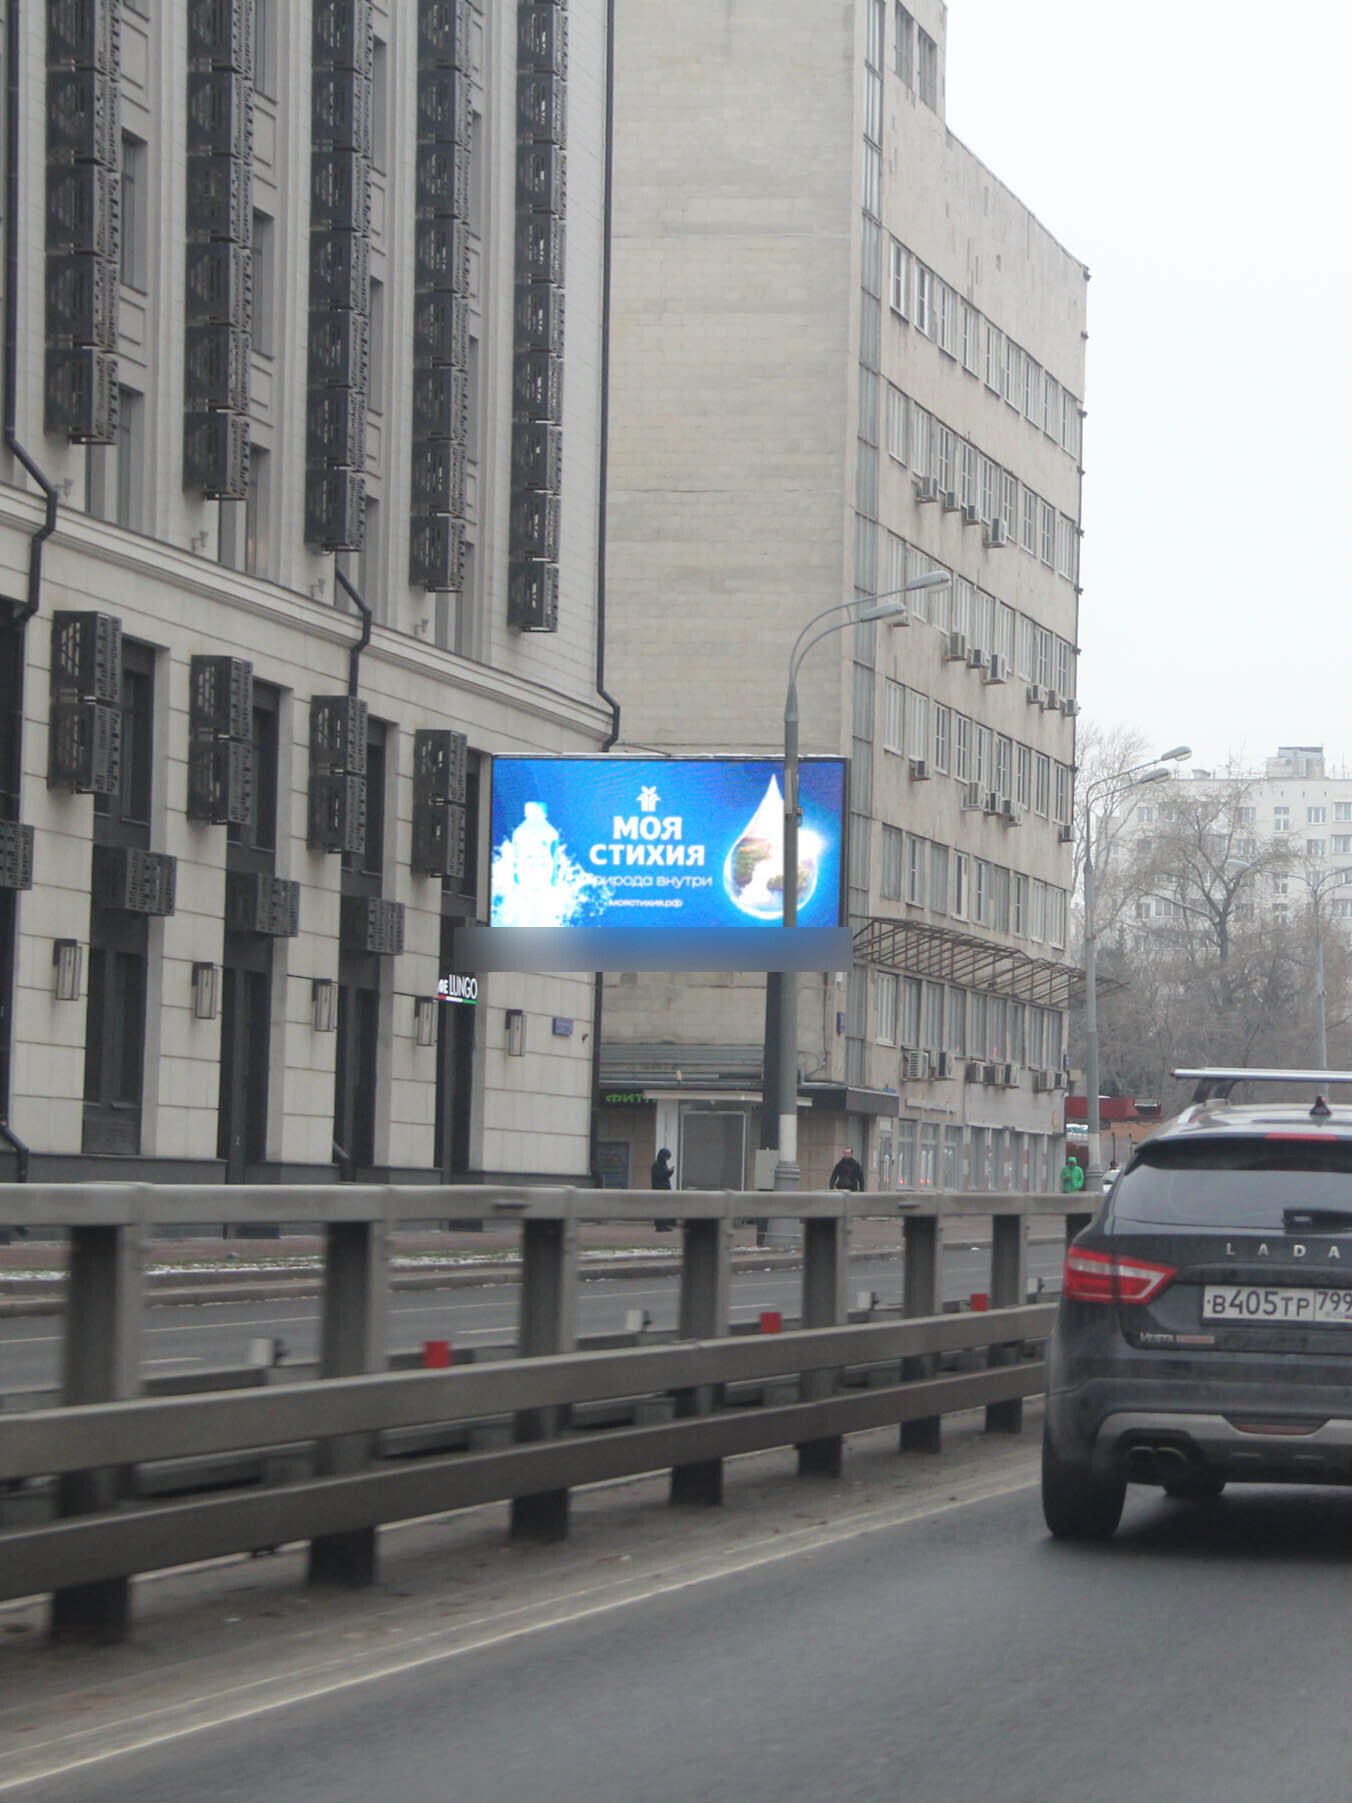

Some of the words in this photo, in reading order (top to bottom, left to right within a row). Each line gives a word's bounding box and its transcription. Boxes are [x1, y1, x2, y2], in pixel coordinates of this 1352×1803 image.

[613, 816, 682, 840] МОЯ
[589, 844, 705, 867] СТИХИЯ
[584, 875, 653, 888] рирода
[656, 875, 713, 889] внутри
[449, 974, 478, 999] LUNGO
[1226, 1243, 1340, 1259] LADA
[1212, 1290, 1310, 1317] В405ТР
